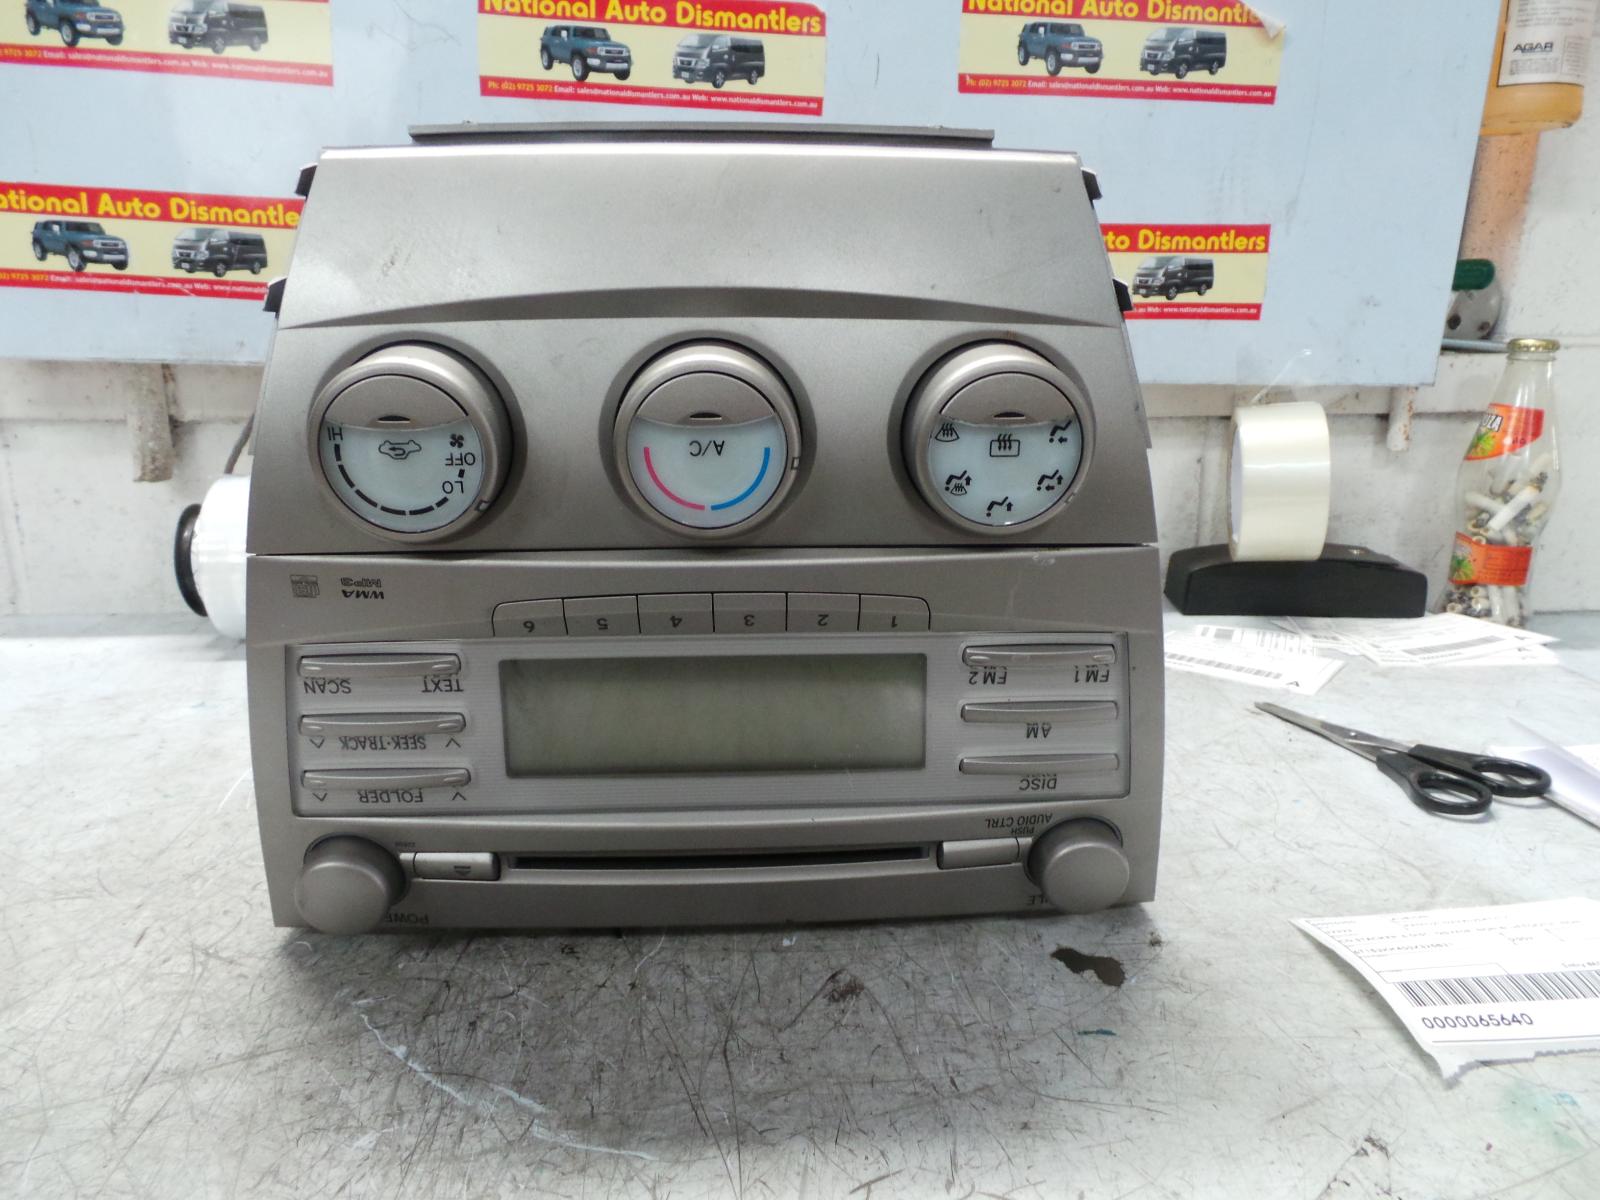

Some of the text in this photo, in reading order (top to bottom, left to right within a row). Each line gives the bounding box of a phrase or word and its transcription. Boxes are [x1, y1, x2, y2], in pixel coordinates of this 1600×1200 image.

[484, 0, 821, 33] National Auto Dismantlers
[1081, 0, 1139, 19] Auto
[1513, 42, 1553, 53] AGAR
[1028, 80, 1046, 89] Email:
[1155, 85, 1171, 93] Web:
[1173, 87, 1272, 98] www.nationaldismantlers.com.au
[554, 85, 575, 94] Email:
[692, 93, 708, 102] Web:
[711, 96, 818, 109] www.nationaldismantlers.com.au
[99, 192, 161, 220] Auto
[1104, 229, 1266, 250] to Dismantlers
[1163, 306, 1257, 314] www.nationaldismantlers.com.au
[327, 427, 343, 441] HI
[689, 440, 725, 457] A/C
[445, 452, 476, 466] OFF
[442, 480, 464, 494] LO
[340, 577, 382, 588] MP3
[341, 589, 385, 600] WMA
[523, 620, 535, 633] 6
[596, 617, 608, 630] 5
[670, 615, 682, 628] 4
[743, 614, 755, 627] 3
[817, 614, 829, 626] 2
[890, 615, 898, 628] 1
[303, 679, 352, 694] SCAN
[422, 678, 464, 693] TEXT
[1026, 724, 1052, 738] AM
[1019, 777, 1058, 791] DISC
[358, 790, 424, 803] FOLDER
[984, 813, 1053, 829] AUDIO CTRL
[1010, 826, 1035, 835] PUSH
[1422, 1013, 1534, 1030] 0000065640
